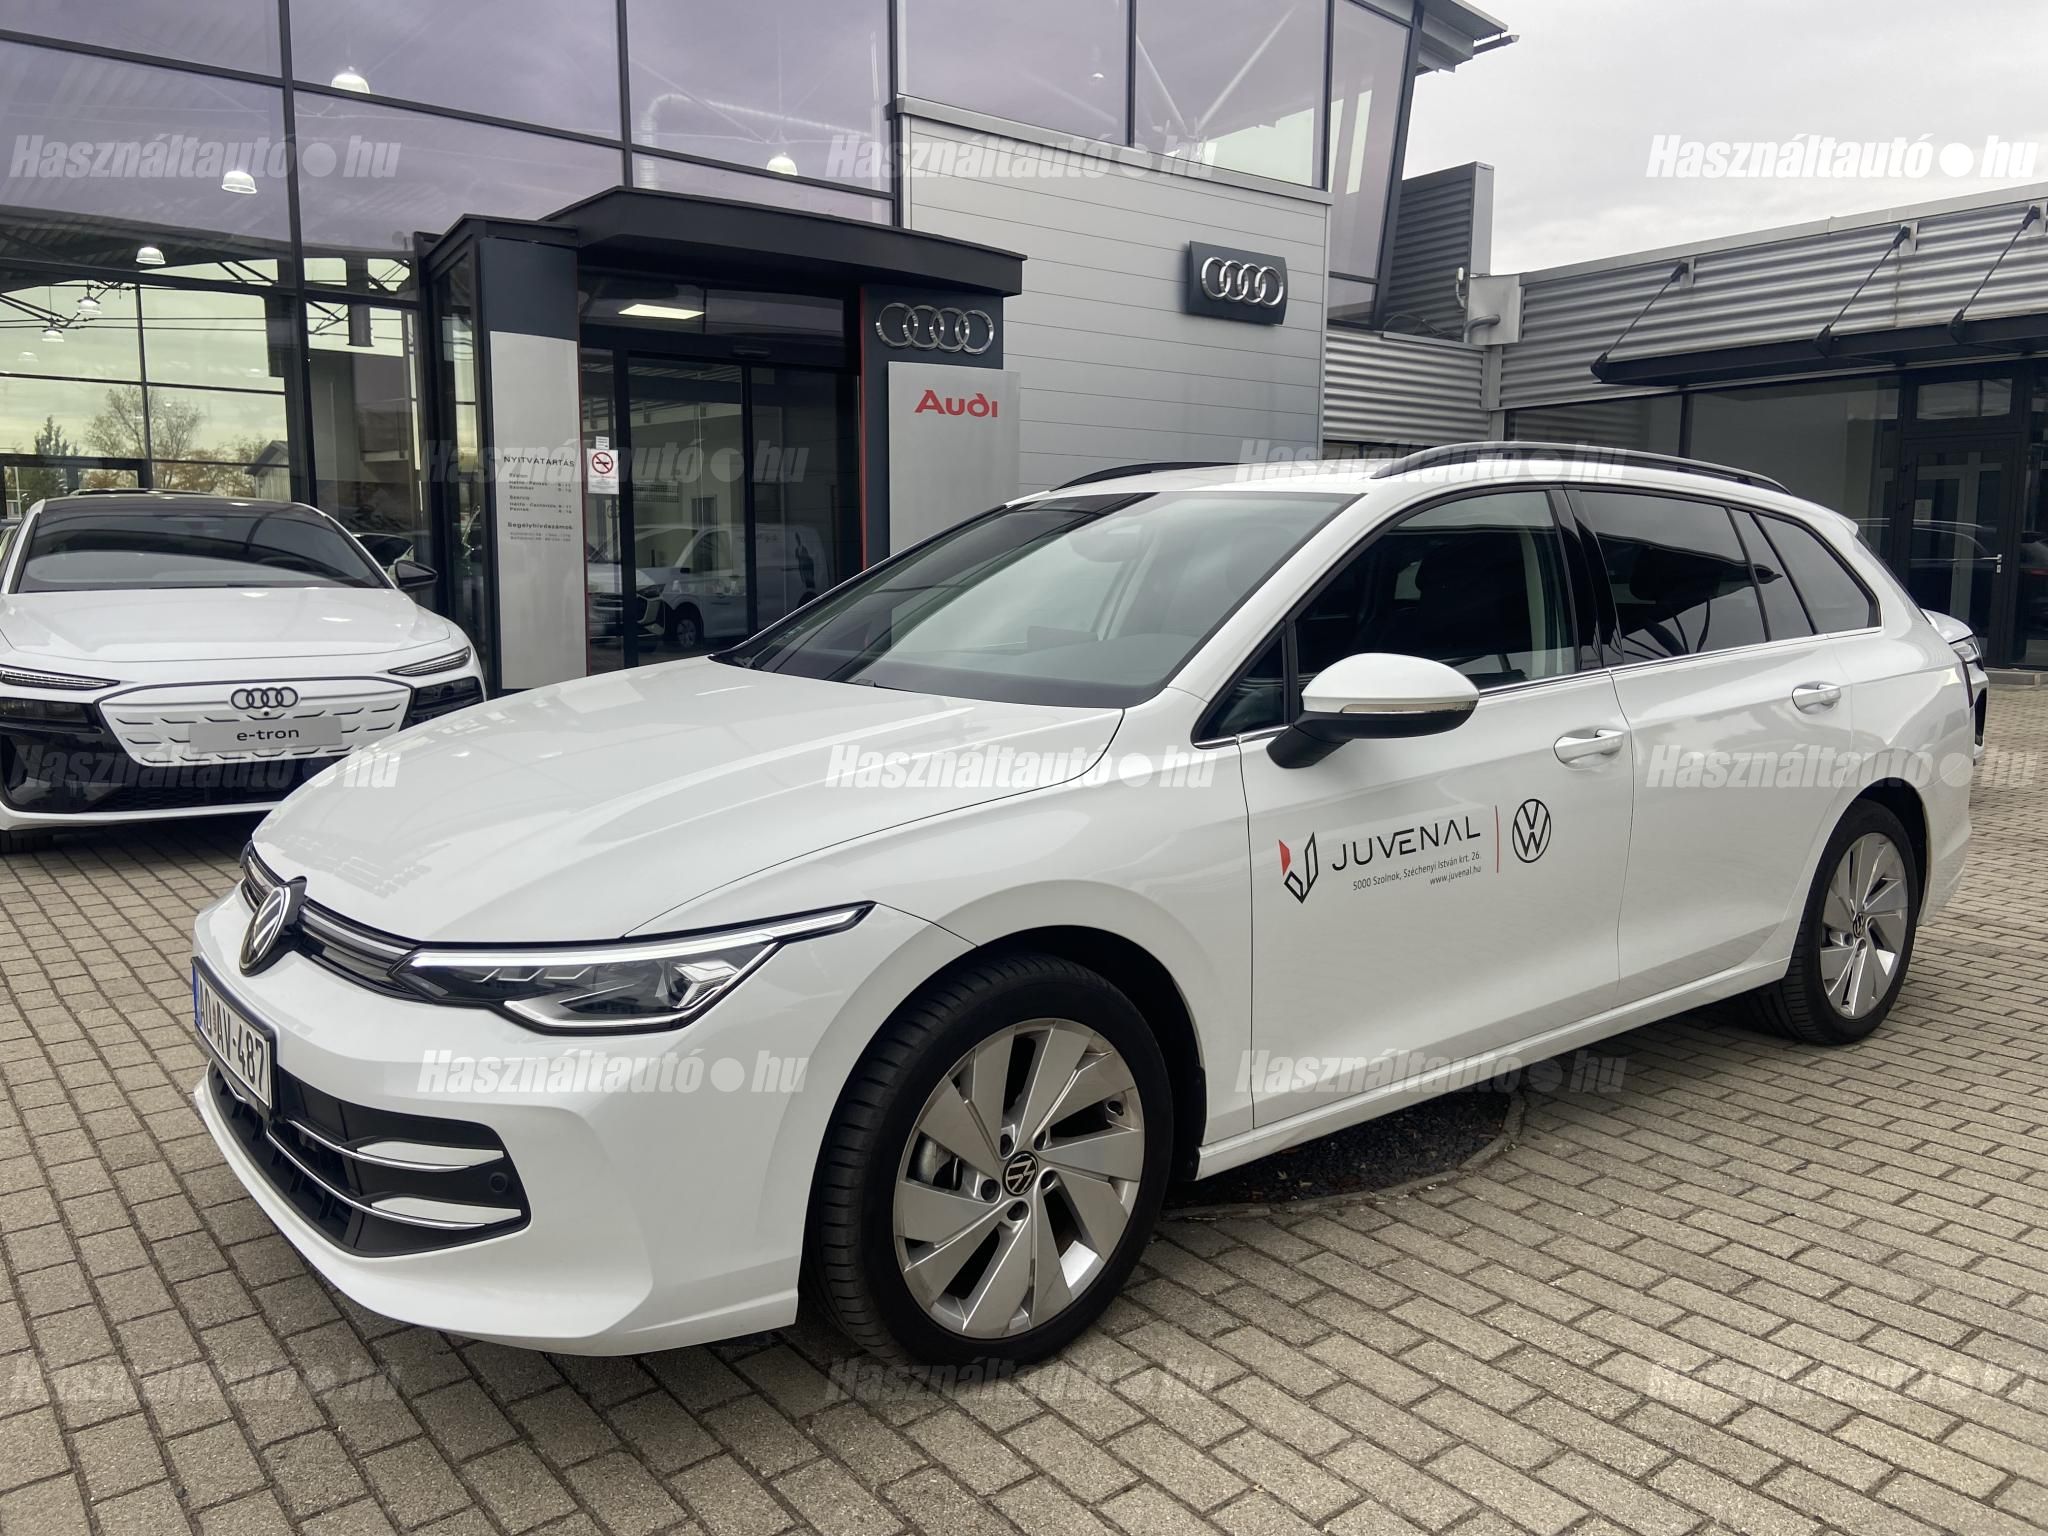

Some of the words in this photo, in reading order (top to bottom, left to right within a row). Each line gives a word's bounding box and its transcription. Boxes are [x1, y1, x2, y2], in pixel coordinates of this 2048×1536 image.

[914, 389, 998, 418] Audi
[236, 729, 300, 741] e-tron
[1331, 815, 1481, 871] JUVENAL
[1352, 877, 1372, 891] 5000
[1373, 872, 1402, 886] Szolnok,
[1403, 862, 1437, 879] Széchenyi
